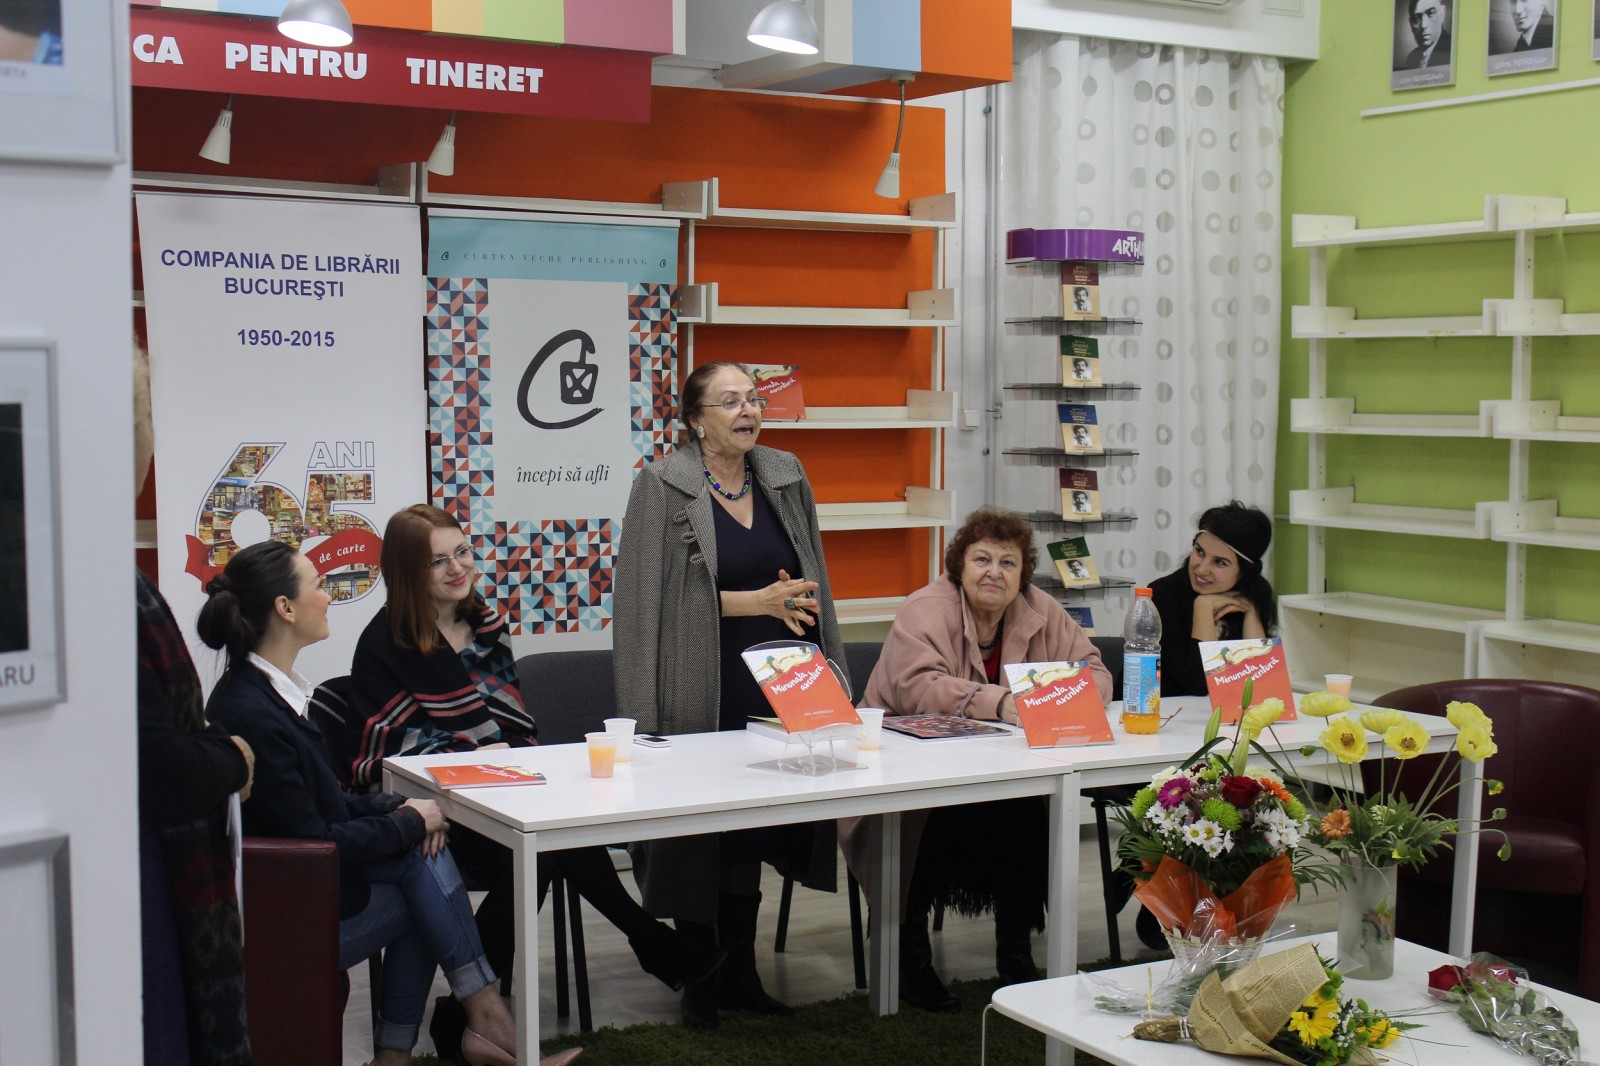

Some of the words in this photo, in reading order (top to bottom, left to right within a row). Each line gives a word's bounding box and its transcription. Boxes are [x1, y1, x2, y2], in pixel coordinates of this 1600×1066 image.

[225, 42, 368, 80] PENTRU
[406, 57, 544, 93] TINERET
[160, 249, 275, 270] COMPANIA
[281, 254, 308, 271] DE
[315, 253, 400, 275] LIBRĂRII
[464, 253, 514, 261] CURTEA
[522, 254, 562, 263] VECHE
[571, 256, 647, 266] PUBLISHING
[237, 328, 335, 348] 1950-2015
[307, 441, 375, 468] ANI
[516, 465, 562, 486] începi
[565, 466, 582, 482] să
[585, 464, 610, 485] afli
[319, 551, 332, 564] de
[337, 544, 365, 557] carte
[0, 663, 35, 688] RU
[770, 671, 809, 695] Minunata
[1214, 663, 1260, 686] Minunata
[1023, 685, 1069, 709] Minunata
[1055, 678, 1089, 707] aventură
